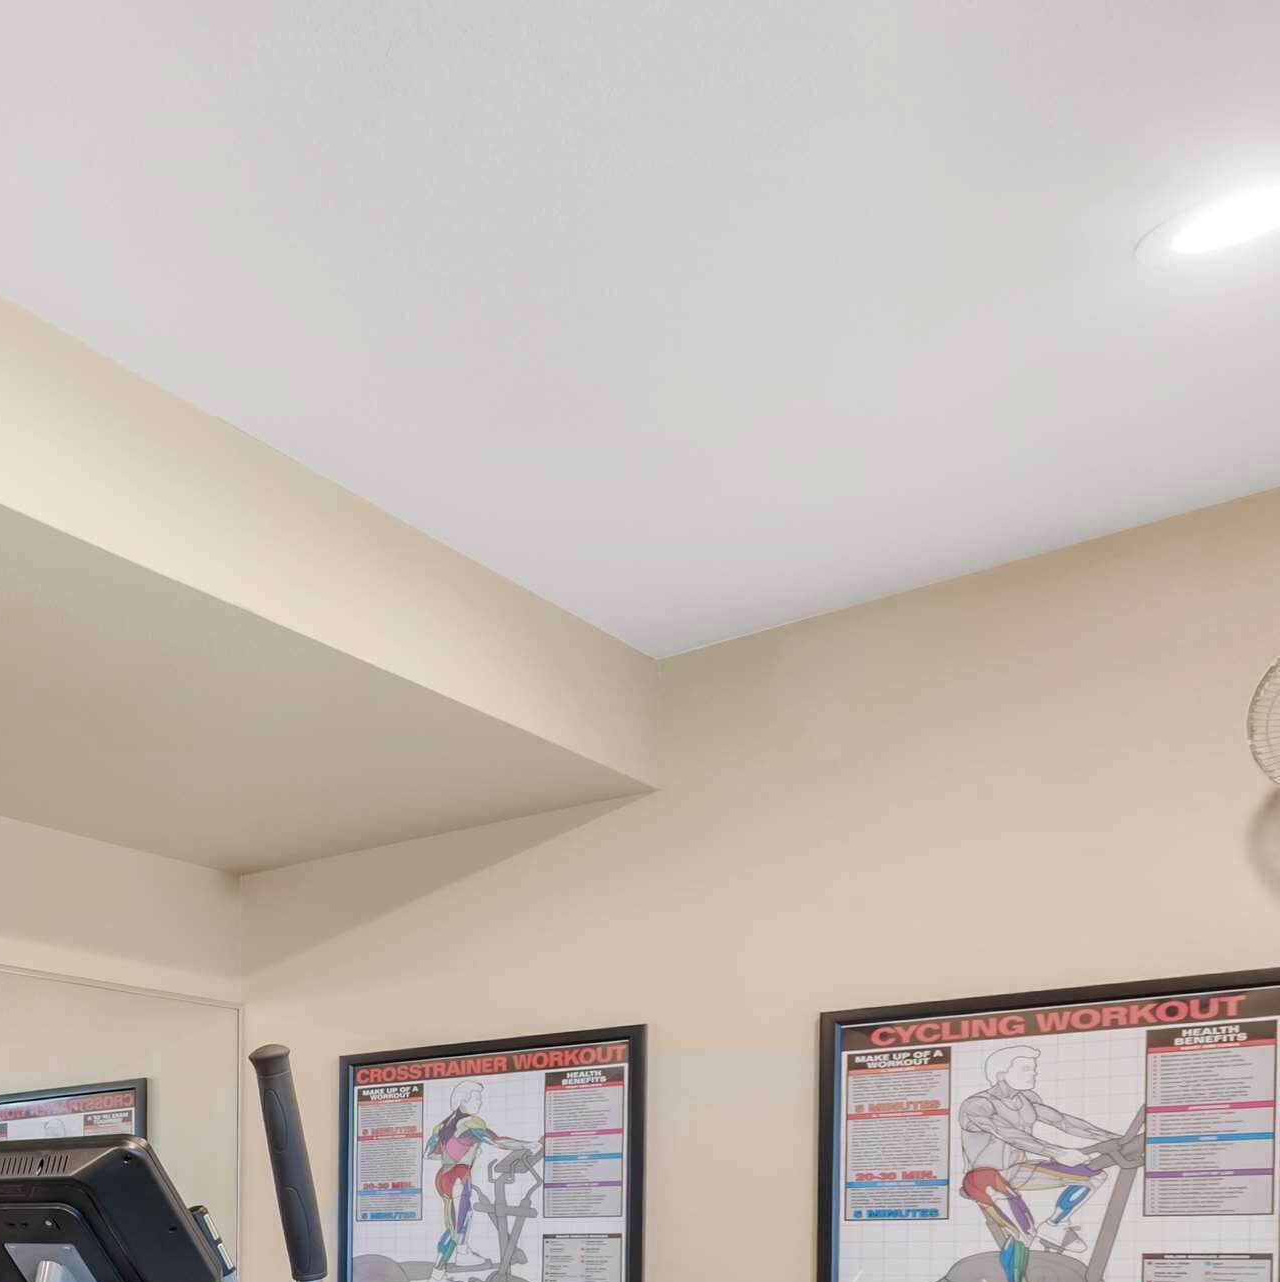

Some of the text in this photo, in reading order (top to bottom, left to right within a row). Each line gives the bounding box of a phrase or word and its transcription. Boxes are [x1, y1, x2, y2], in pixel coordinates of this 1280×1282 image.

[870, 994, 1247, 1047] CYCLING WORKOUT
[1181, 1025, 1241, 1038] HEALTH
[1173, 1032, 1248, 1047] BENEFITS
[854, 1054, 890, 1064] MAKE
[894, 1053, 911, 1061] UP
[912, 1051, 930, 1059] OF
[356, 1045, 627, 1084] CROSSTRAINER WORKOUT
[866, 1058, 931, 1069] WORKOUT
[566, 1070, 602, 1079] HEALTH
[561, 1076, 607, 1085] BENEFITS
[362, 1085, 419, 1096] MAKE UP OF A
[369, 1091, 410, 1101] WORKOUT
[854, 1171, 897, 1182] 20-30
